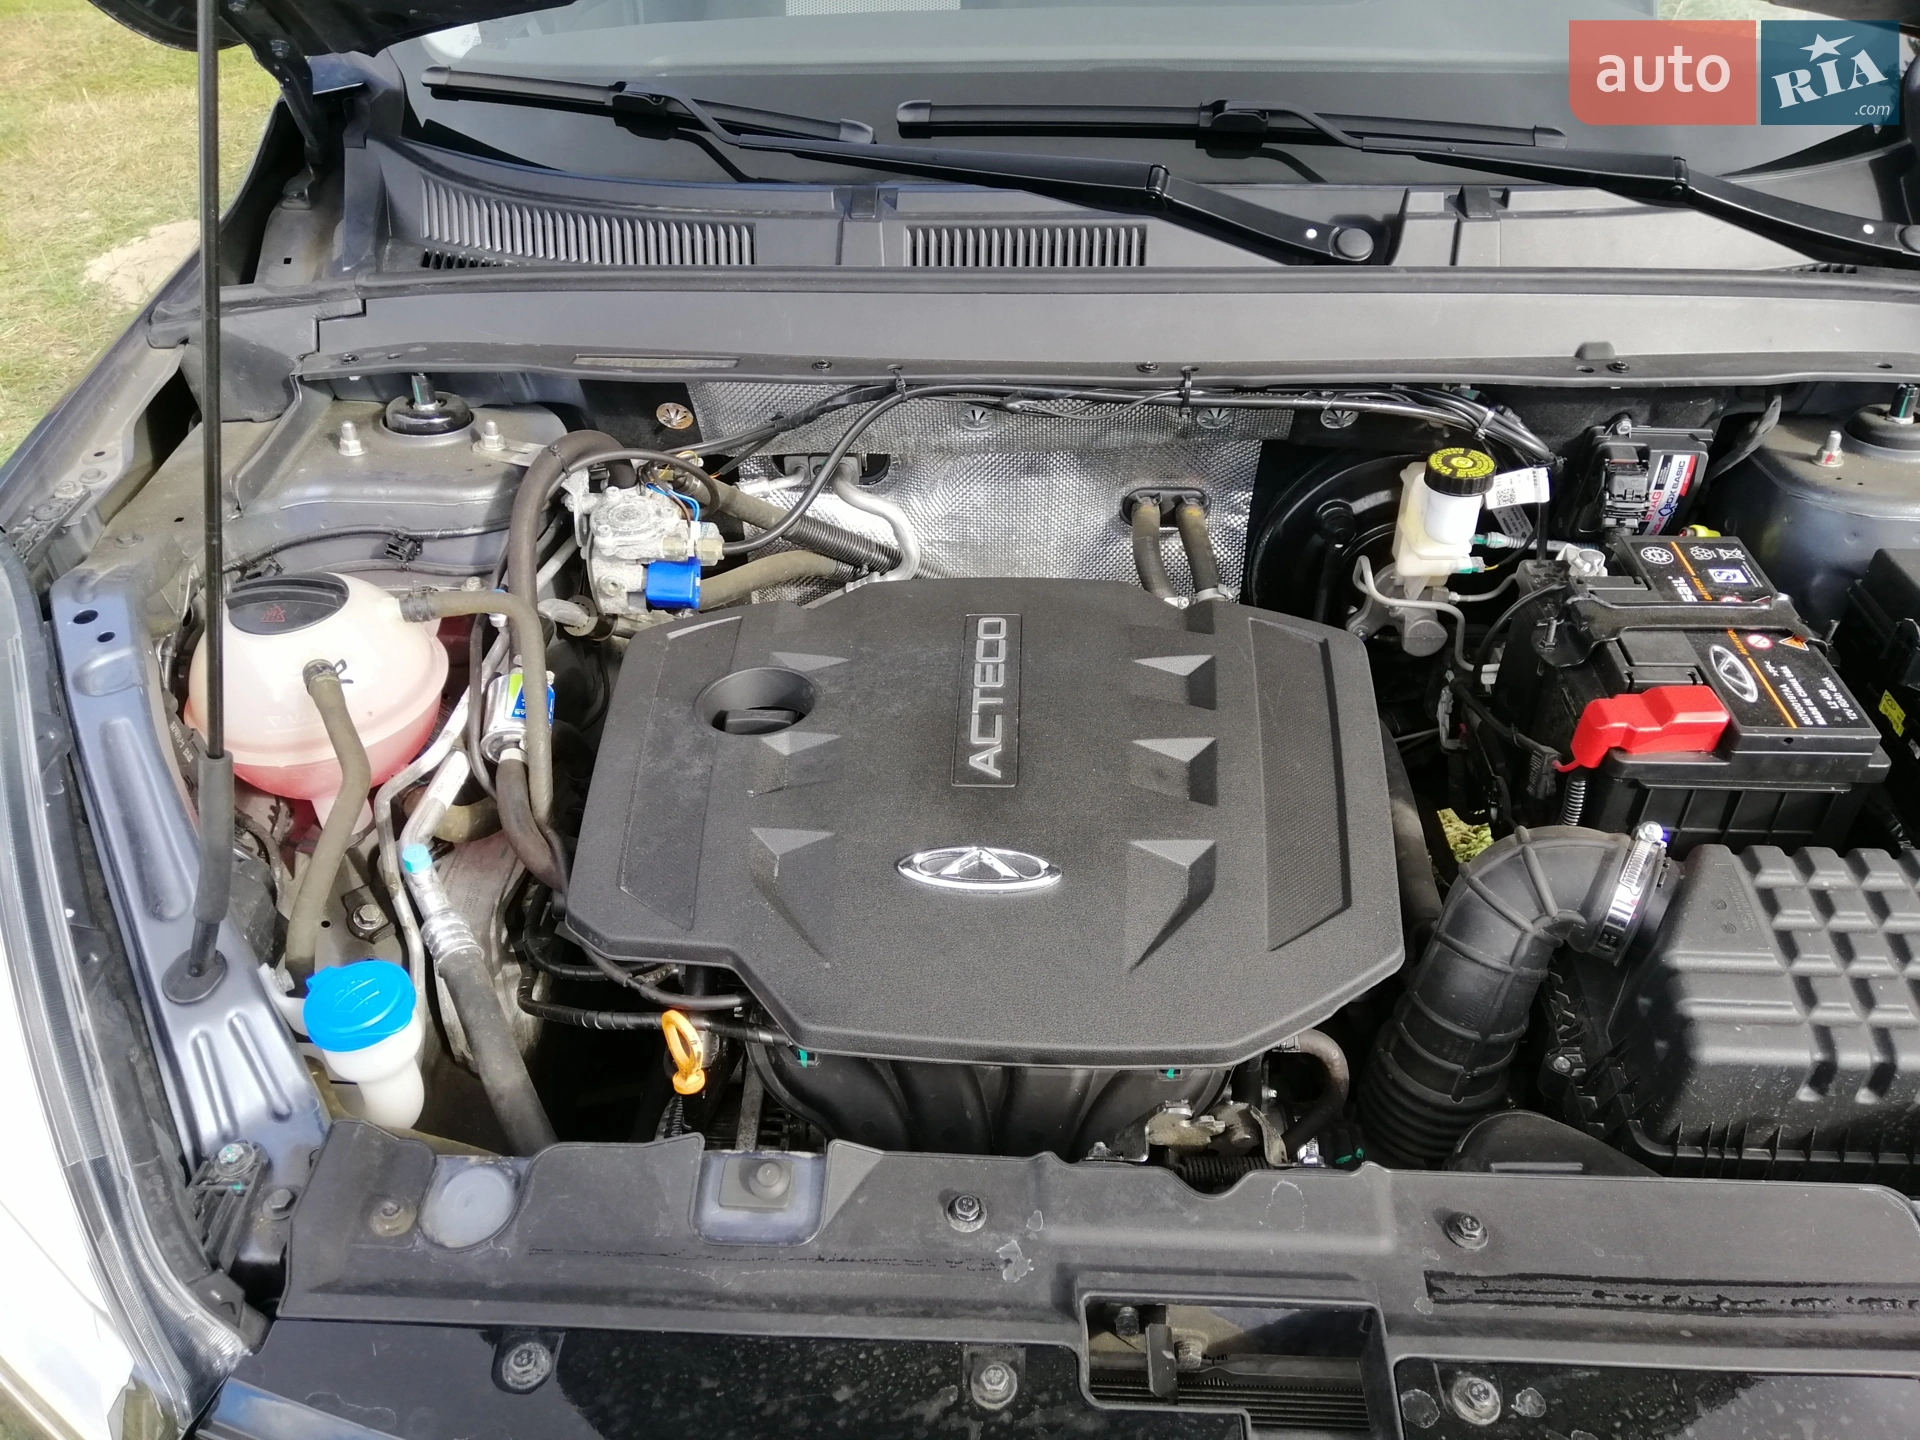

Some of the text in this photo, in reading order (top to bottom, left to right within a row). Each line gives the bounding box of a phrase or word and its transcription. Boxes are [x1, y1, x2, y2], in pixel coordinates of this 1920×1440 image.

[1672, 461, 1686, 490] BASIC
[1691, 576, 1713, 601] BATTERY
[969, 616, 1007, 778] ACTECO
[1788, 677, 1808, 697] CHINA
[1802, 698, 1815, 706] IN
[1818, 688, 1840, 710] L2 400
[1808, 706, 1828, 725] MADE
[1842, 708, 1859, 721] 12V
